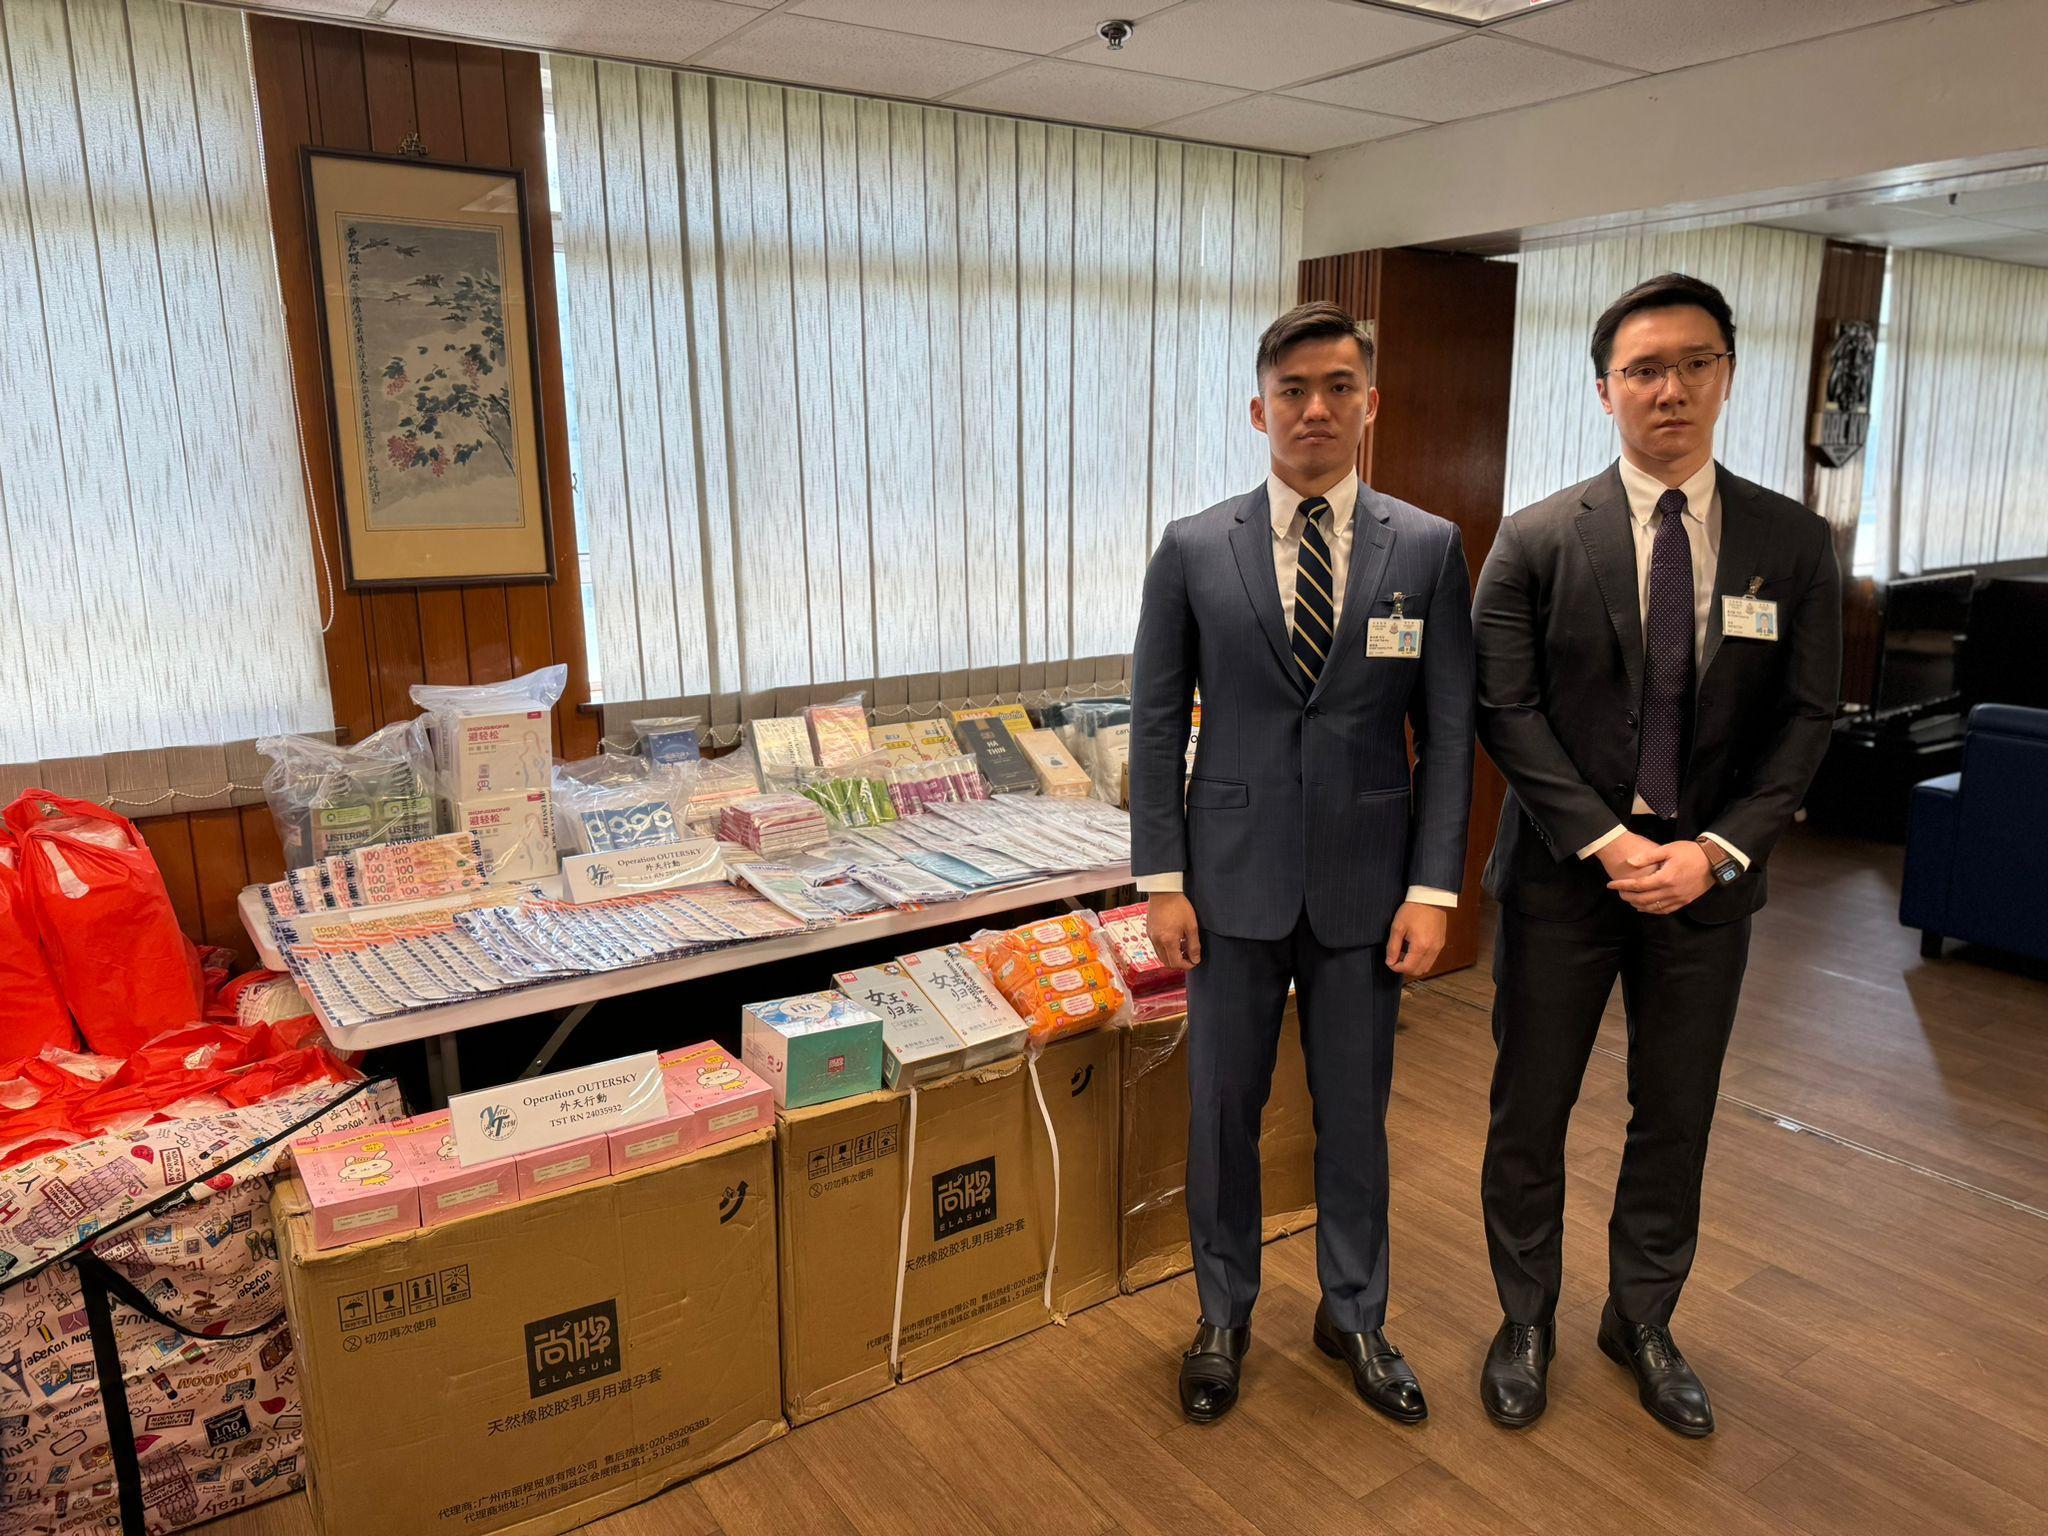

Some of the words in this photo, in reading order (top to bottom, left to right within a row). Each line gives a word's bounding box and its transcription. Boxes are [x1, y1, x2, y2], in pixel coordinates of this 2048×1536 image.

[987, 747, 1006, 756] THIN
[325, 829, 370, 842] LISTERINE
[362, 851, 380, 862] 100
[391, 846, 408, 857] 100
[617, 855, 656, 868] Operation
[657, 847, 701, 863] OUTERSKY
[366, 863, 384, 873] 100
[395, 865, 414, 875] 100
[645, 859, 681, 872] 外天行動
[366, 875, 386, 884] 100
[396, 875, 415, 885] 100
[368, 886, 386, 895] 100
[400, 886, 419, 896] 100
[315, 926, 342, 934] 1000
[864, 989, 905, 1007] 女王
[886, 1001, 923, 1020] 归来
[522, 1089, 575, 1107] Operation
[577, 1073, 638, 1095] OUTERSKY
[559, 1093, 609, 1112] 外天行動
[549, 1115, 568, 1128] TST
[570, 1112, 585, 1123] RN
[586, 1104, 624, 1119] 24035932
[823, 1168, 874, 1193] 切勿再次使用
[939, 1207, 993, 1233] ELASUN
[904, 1217, 1026, 1274] 天然橡胶胶乳男用避孕套
[251, 1281, 271, 1299] BON
[71, 1331, 93, 1346] BON
[364, 1317, 437, 1345] 切勿再次使用
[24, 1340, 69, 1369] voyage!
[538, 1358, 613, 1388] ELASUN
[83, 1398, 99, 1409] BON
[488, 1366, 663, 1437] 天然橡胶胶乳男用避孕套
[213, 1420, 241, 1437] OUT
[438, 1459, 598, 1521] 代理商:广州市丽程贸易有限公司
[200, 1495, 246, 1516] Italy
[59, 1500, 120, 1534] ONDON
